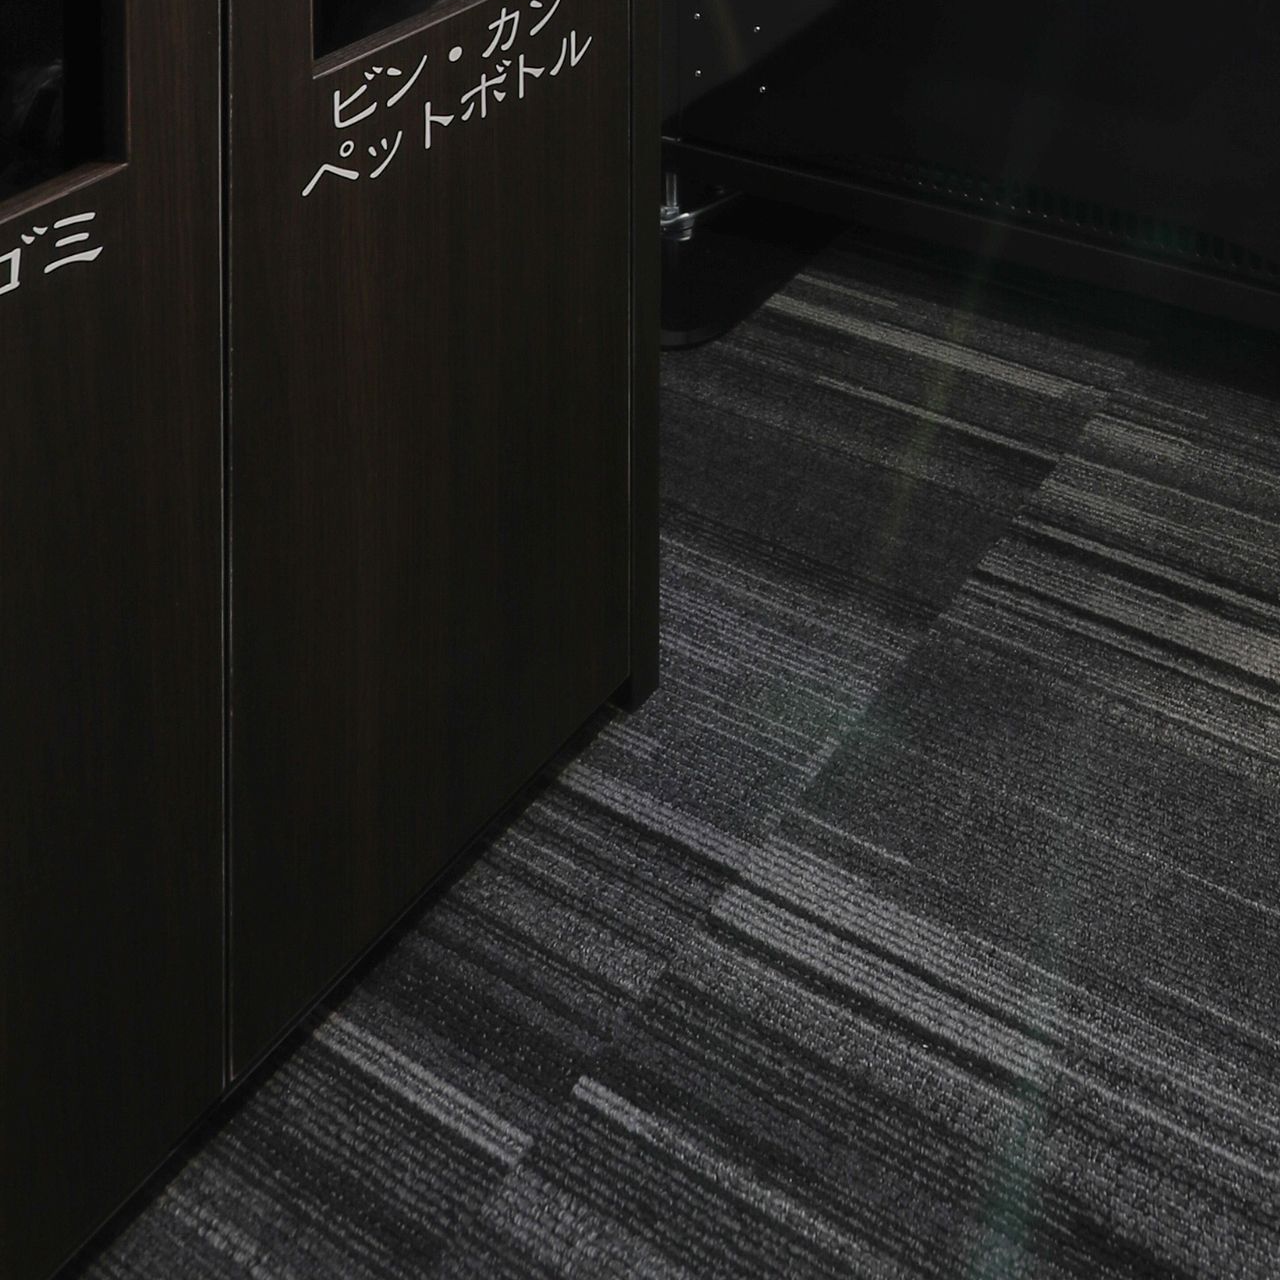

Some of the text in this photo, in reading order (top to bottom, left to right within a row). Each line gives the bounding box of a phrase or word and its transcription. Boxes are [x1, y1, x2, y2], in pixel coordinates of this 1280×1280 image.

[302, 30, 593, 198] ペットボトル
